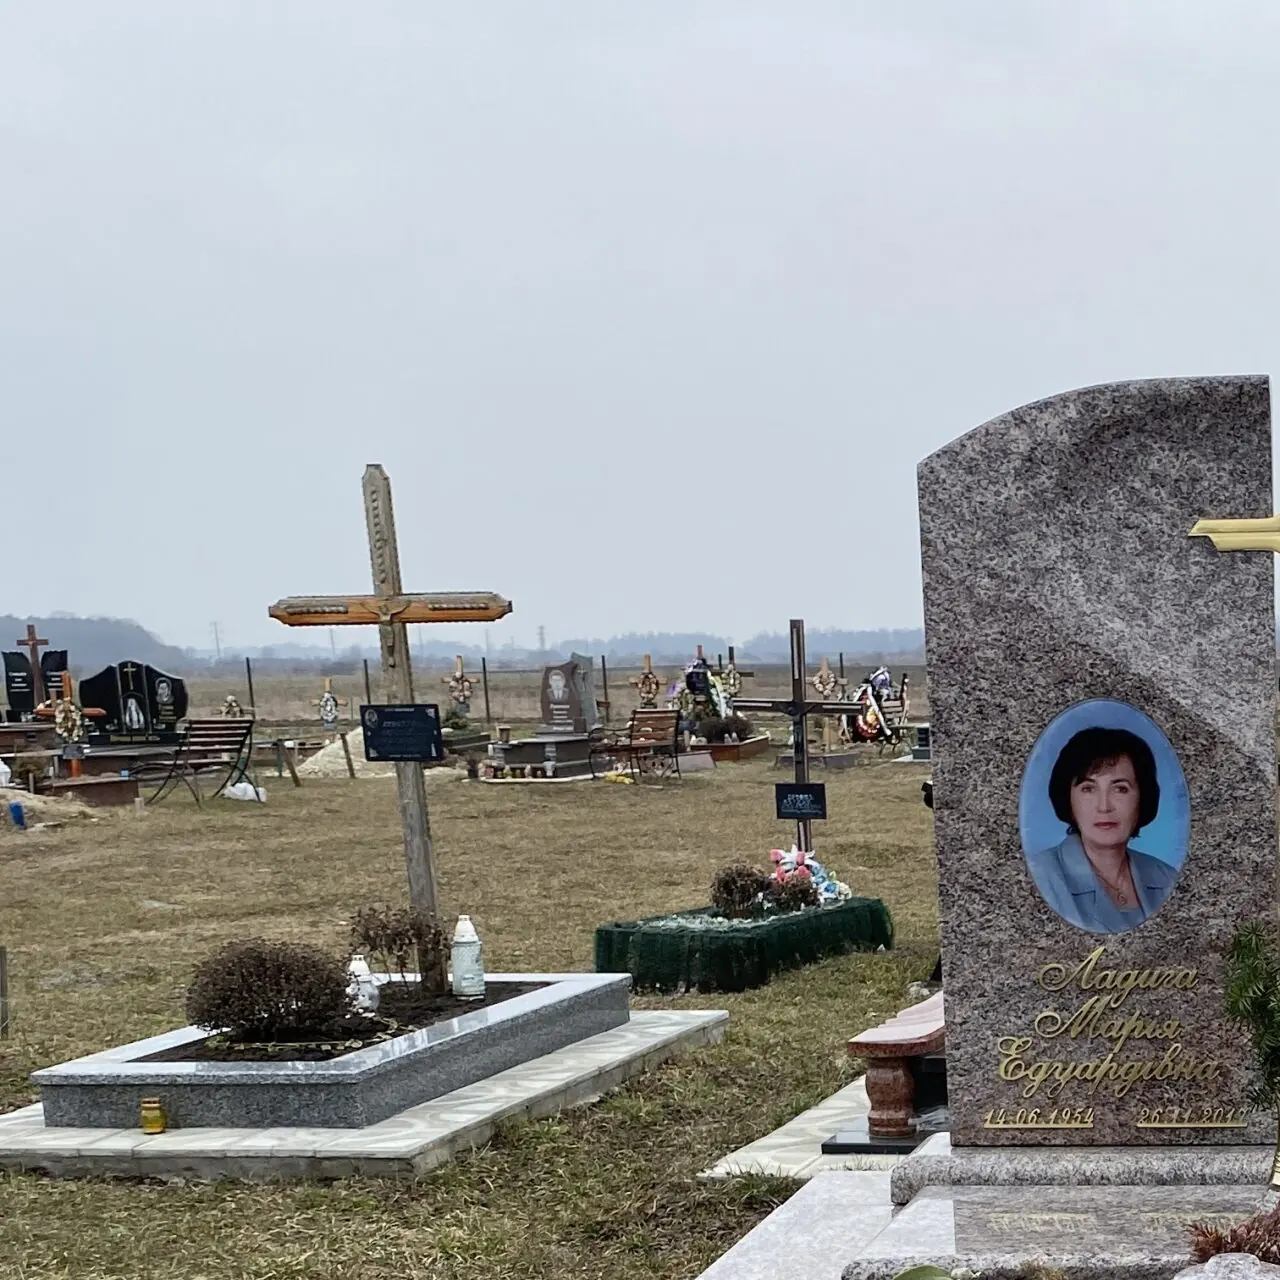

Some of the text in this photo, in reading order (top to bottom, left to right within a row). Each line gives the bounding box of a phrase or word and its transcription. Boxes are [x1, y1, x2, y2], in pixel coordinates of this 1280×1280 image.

[1038, 945, 1199, 1009] Ладига
[1034, 994, 1183, 1054] Марія
[998, 1035, 1220, 1099] Едуардівна
